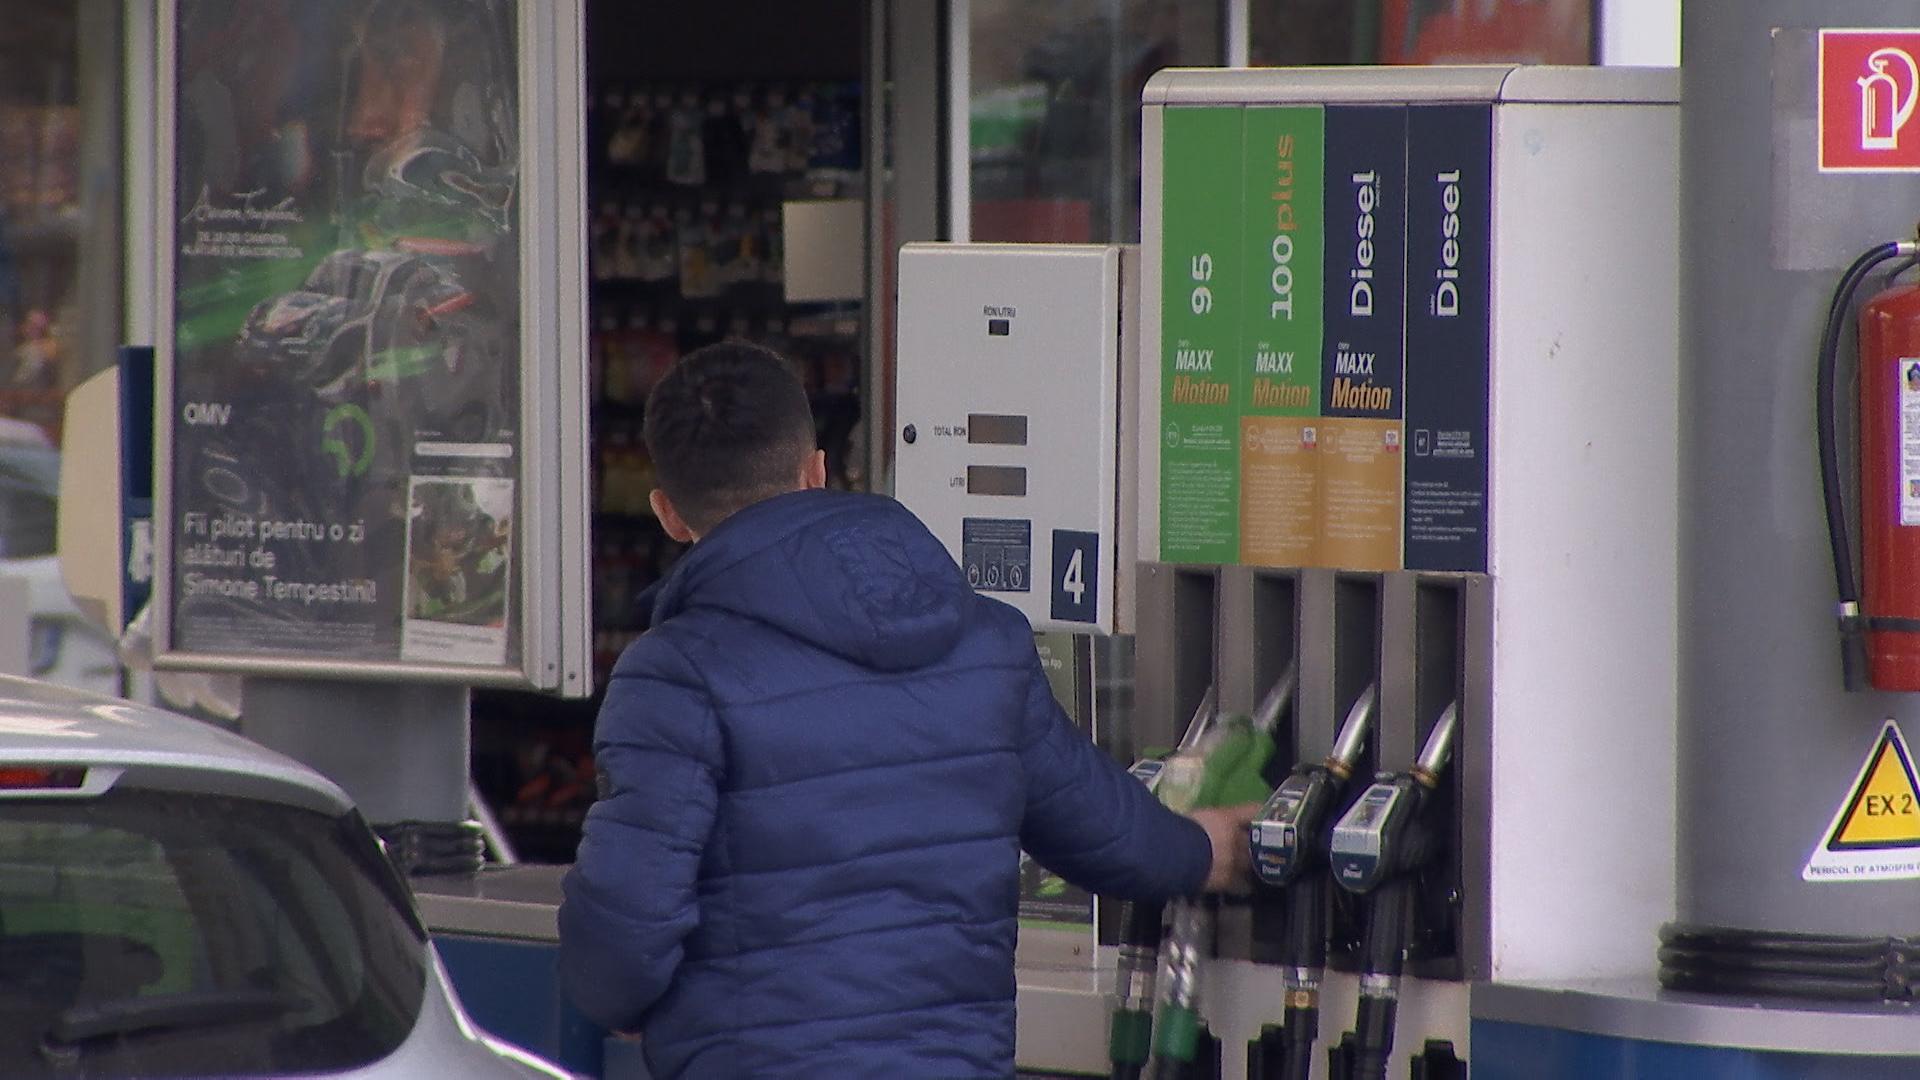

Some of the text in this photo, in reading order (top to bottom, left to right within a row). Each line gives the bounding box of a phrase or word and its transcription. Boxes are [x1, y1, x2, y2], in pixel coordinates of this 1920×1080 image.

[1351, 169, 1375, 316] Diesel
[1436, 169, 1460, 316] Diesel
[1191, 253, 1213, 315] 95
[1174, 350, 1215, 371] MAXX
[1255, 352, 1296, 373] MAXX
[1334, 352, 1377, 374] MAXX
[1172, 375, 1230, 404] Motion
[1252, 376, 1311, 407] Motion
[1331, 376, 1393, 410] Motion
[184, 402, 232, 425] OMV
[934, 426, 952, 437] TOTAL
[210, 512, 257, 541] pilot
[259, 519, 325, 541] pentru
[329, 523, 344, 541] o
[348, 519, 366, 543] zi
[249, 546, 276, 568] de
[184, 572, 259, 598] Simone
[1063, 548, 1085, 604] 4
[1866, 793, 1913, 816] EX 2
[1810, 865, 1849, 875] PERICOL
[1853, 865, 1865, 875] DE
